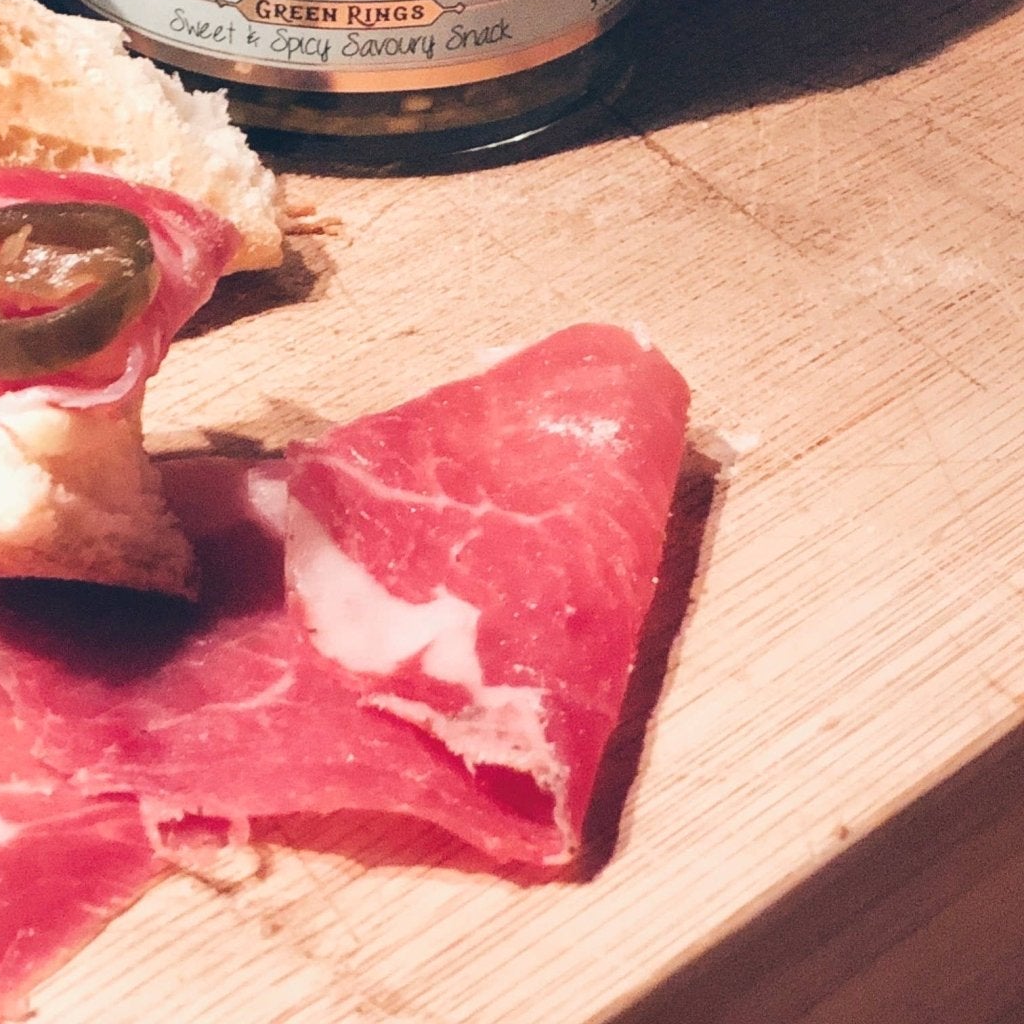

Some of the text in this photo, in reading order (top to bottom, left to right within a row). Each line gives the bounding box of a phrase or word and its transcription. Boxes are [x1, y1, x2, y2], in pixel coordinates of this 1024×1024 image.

[255, 0, 425, 27] GREEN RINGS
[169, 7, 513, 63] Sweet & Spicy Savoury Snack
